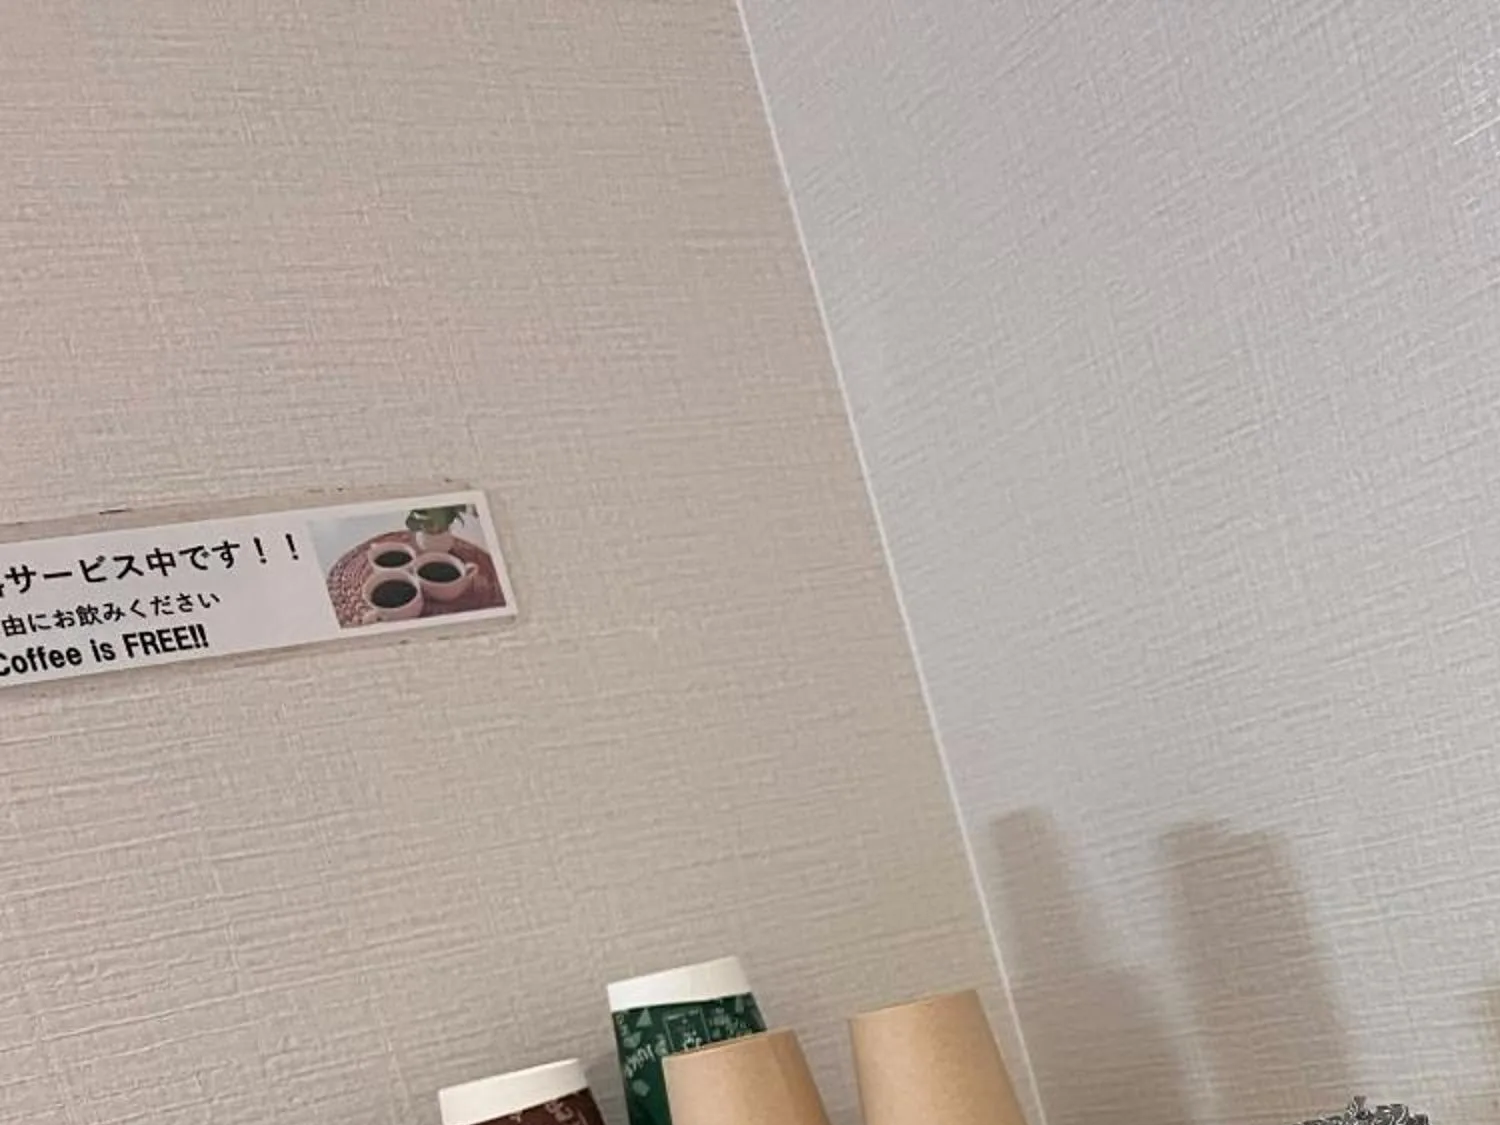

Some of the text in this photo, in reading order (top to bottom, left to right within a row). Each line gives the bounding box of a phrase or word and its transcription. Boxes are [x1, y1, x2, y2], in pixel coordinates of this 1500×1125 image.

[0, 533, 300, 597] サービス中です！！
[90, 639, 116, 662] is
[122, 623, 209, 659] FREE!!
